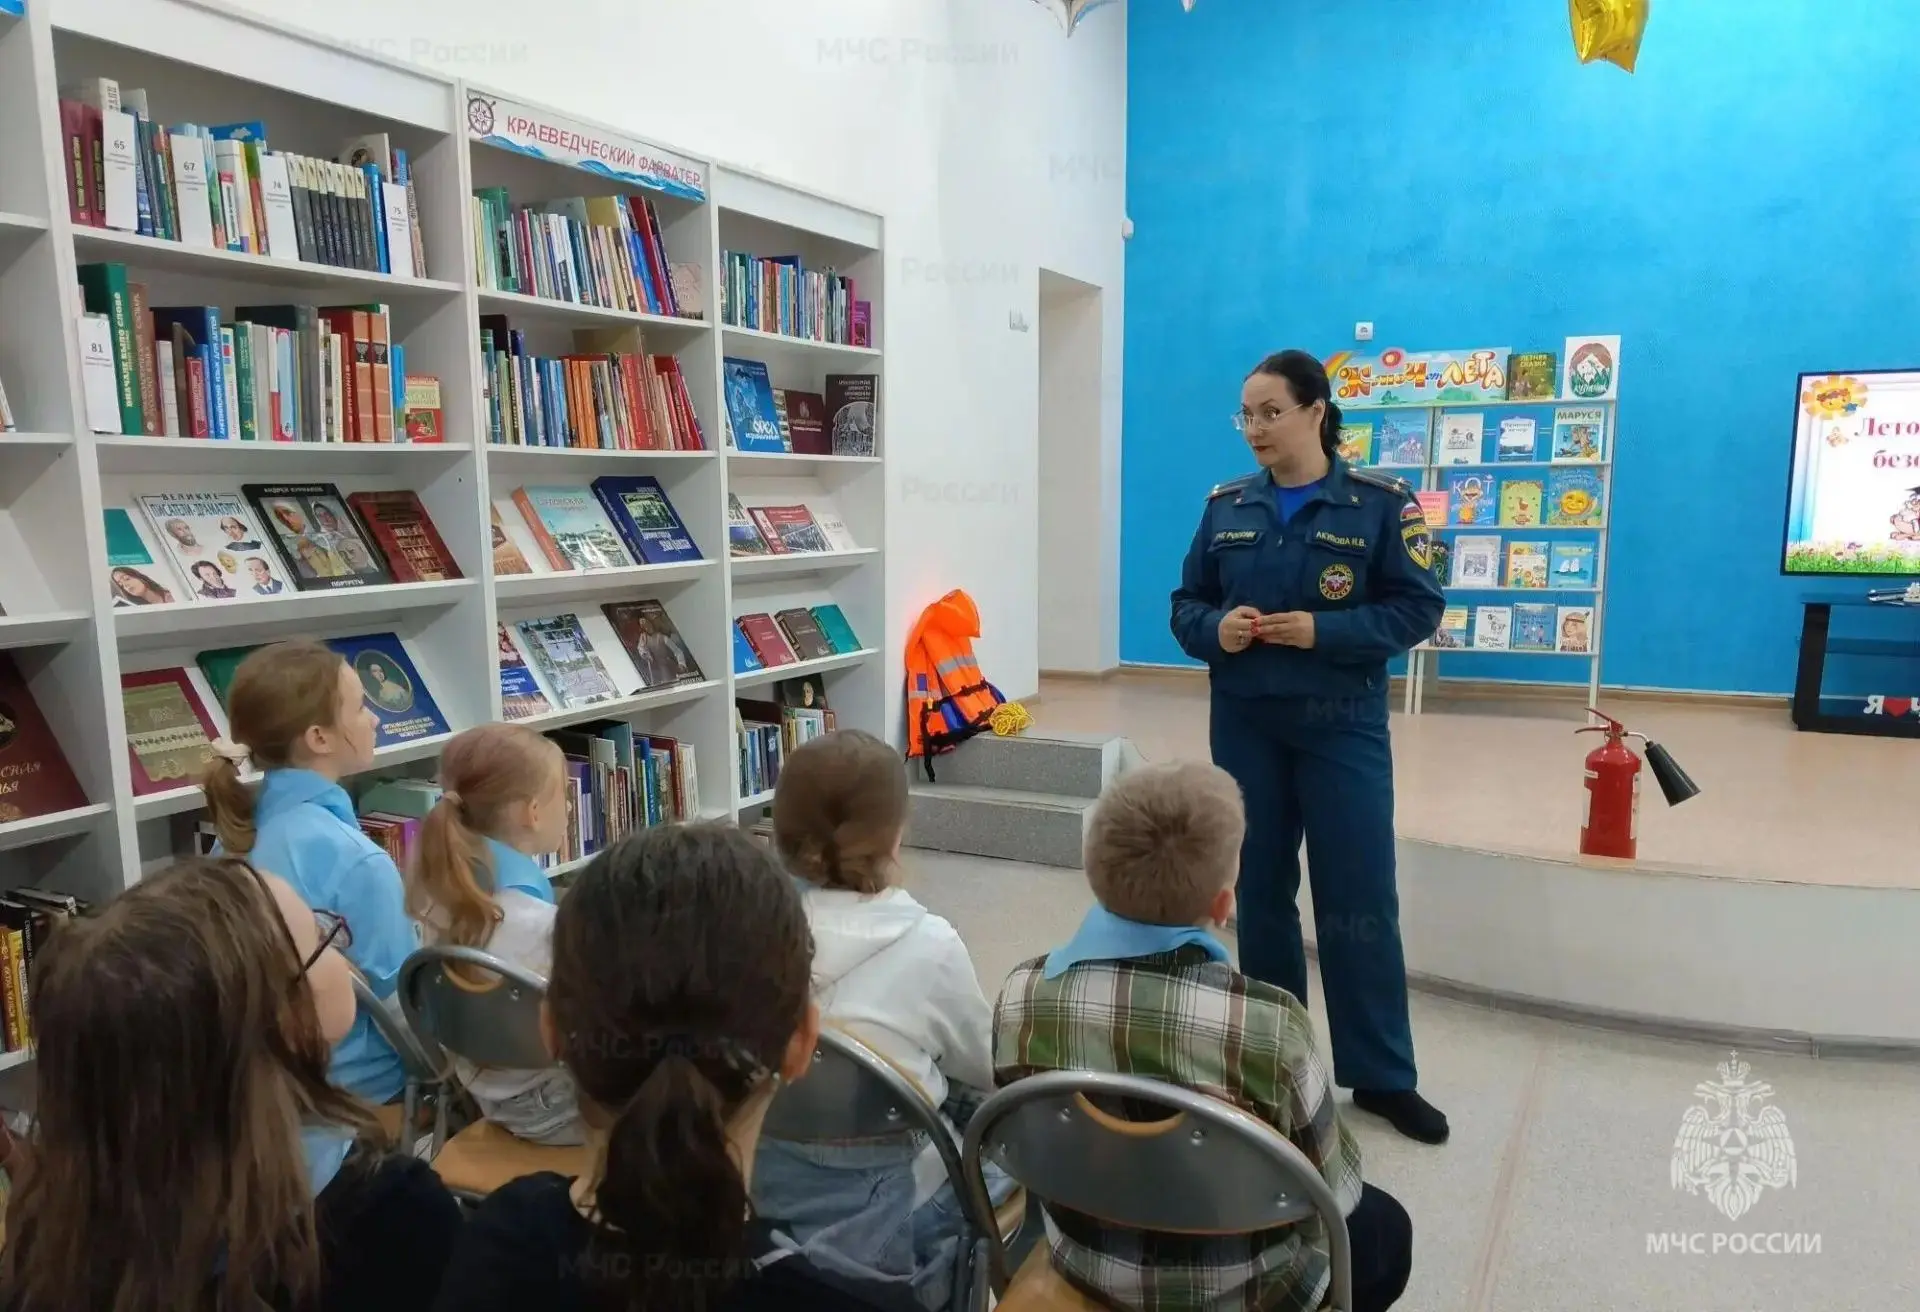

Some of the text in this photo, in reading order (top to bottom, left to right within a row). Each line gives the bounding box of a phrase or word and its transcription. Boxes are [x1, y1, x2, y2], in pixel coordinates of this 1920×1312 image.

[113, 140, 125, 150] 65
[506, 115, 702, 188] КРАЕВЕДЧЕСКИЙ ФАРВАТЕР
[183, 161, 196, 171] 67
[91, 343, 104, 353] 81
[1438, 351, 1507, 389] ЛЕТА
[1557, 411, 1601, 421] МАРУСЯ
[1854, 416, 1920, 437] Лето
[161, 493, 219, 501] ВЕЛИКИЕ
[1863, 695, 1885, 715] Я
